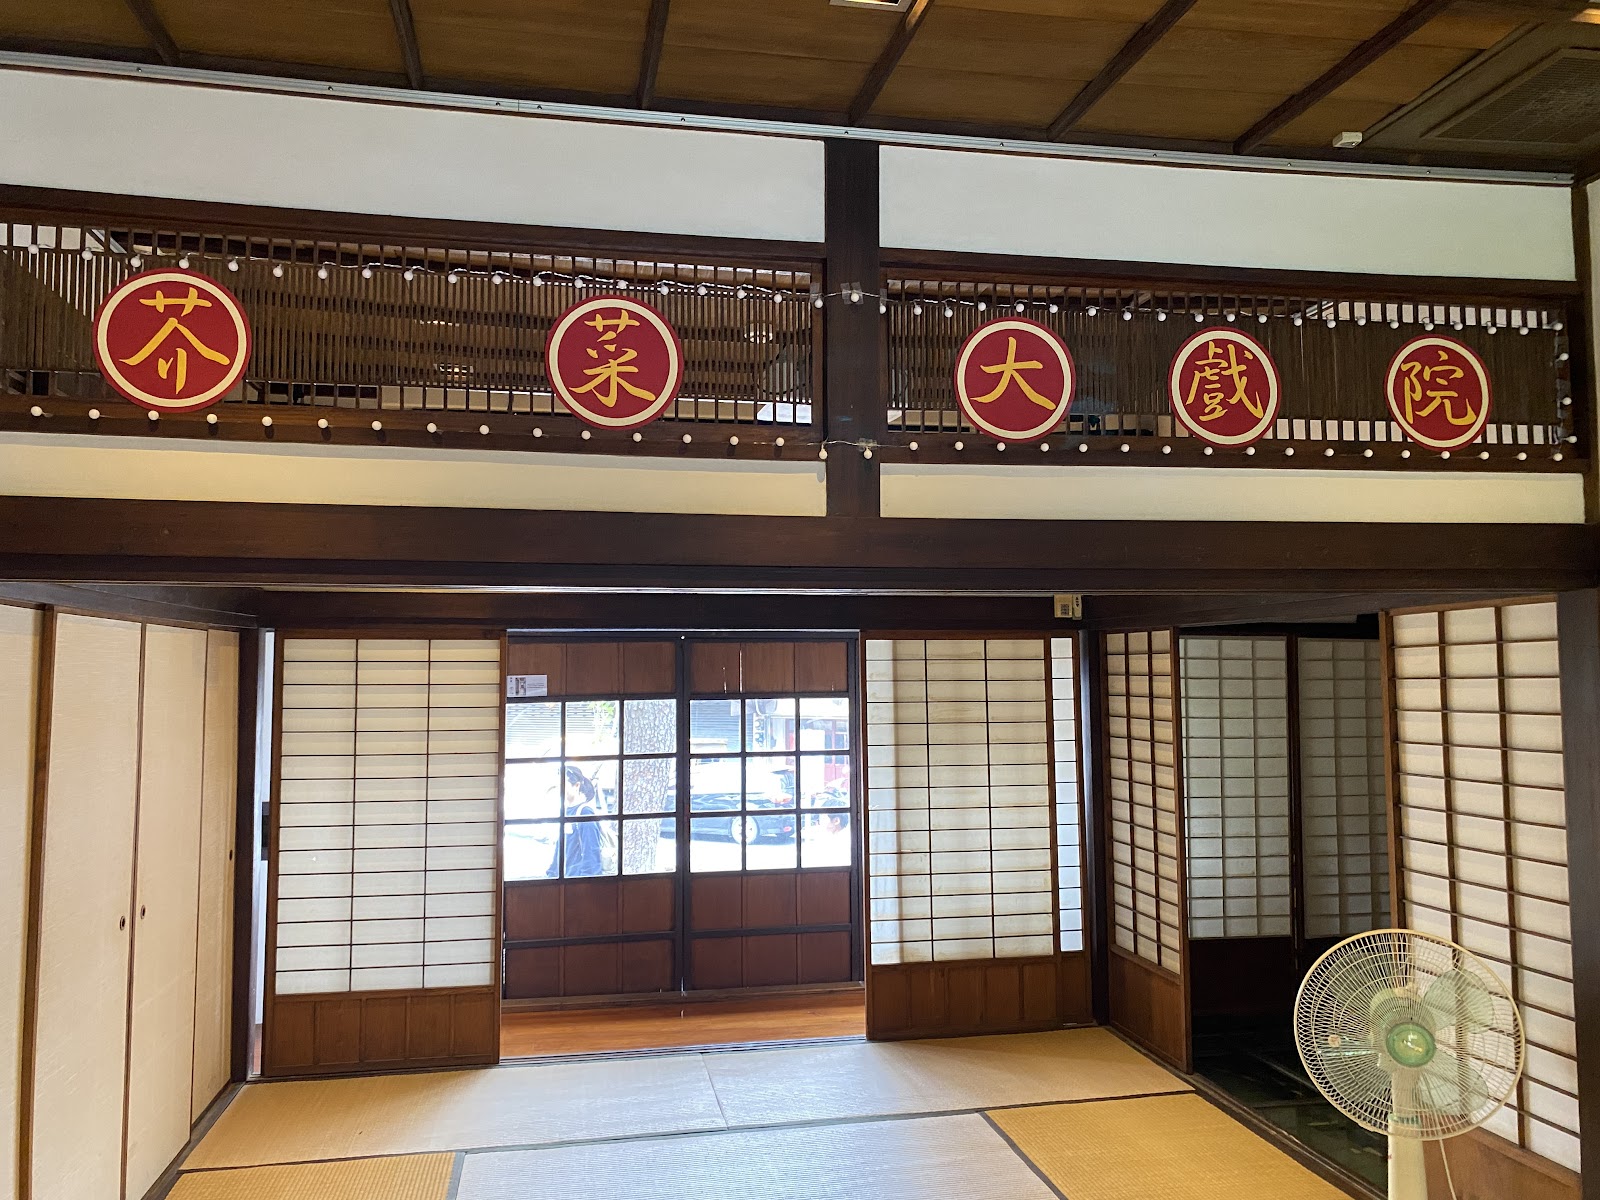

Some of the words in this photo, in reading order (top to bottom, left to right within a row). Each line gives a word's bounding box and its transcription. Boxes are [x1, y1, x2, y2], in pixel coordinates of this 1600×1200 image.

[119, 286, 230, 395] 芥
[570, 309, 657, 408] 菜
[970, 336, 1057, 411] 大
[1186, 340, 1264, 422] 戲
[1400, 350, 1477, 426] 院
